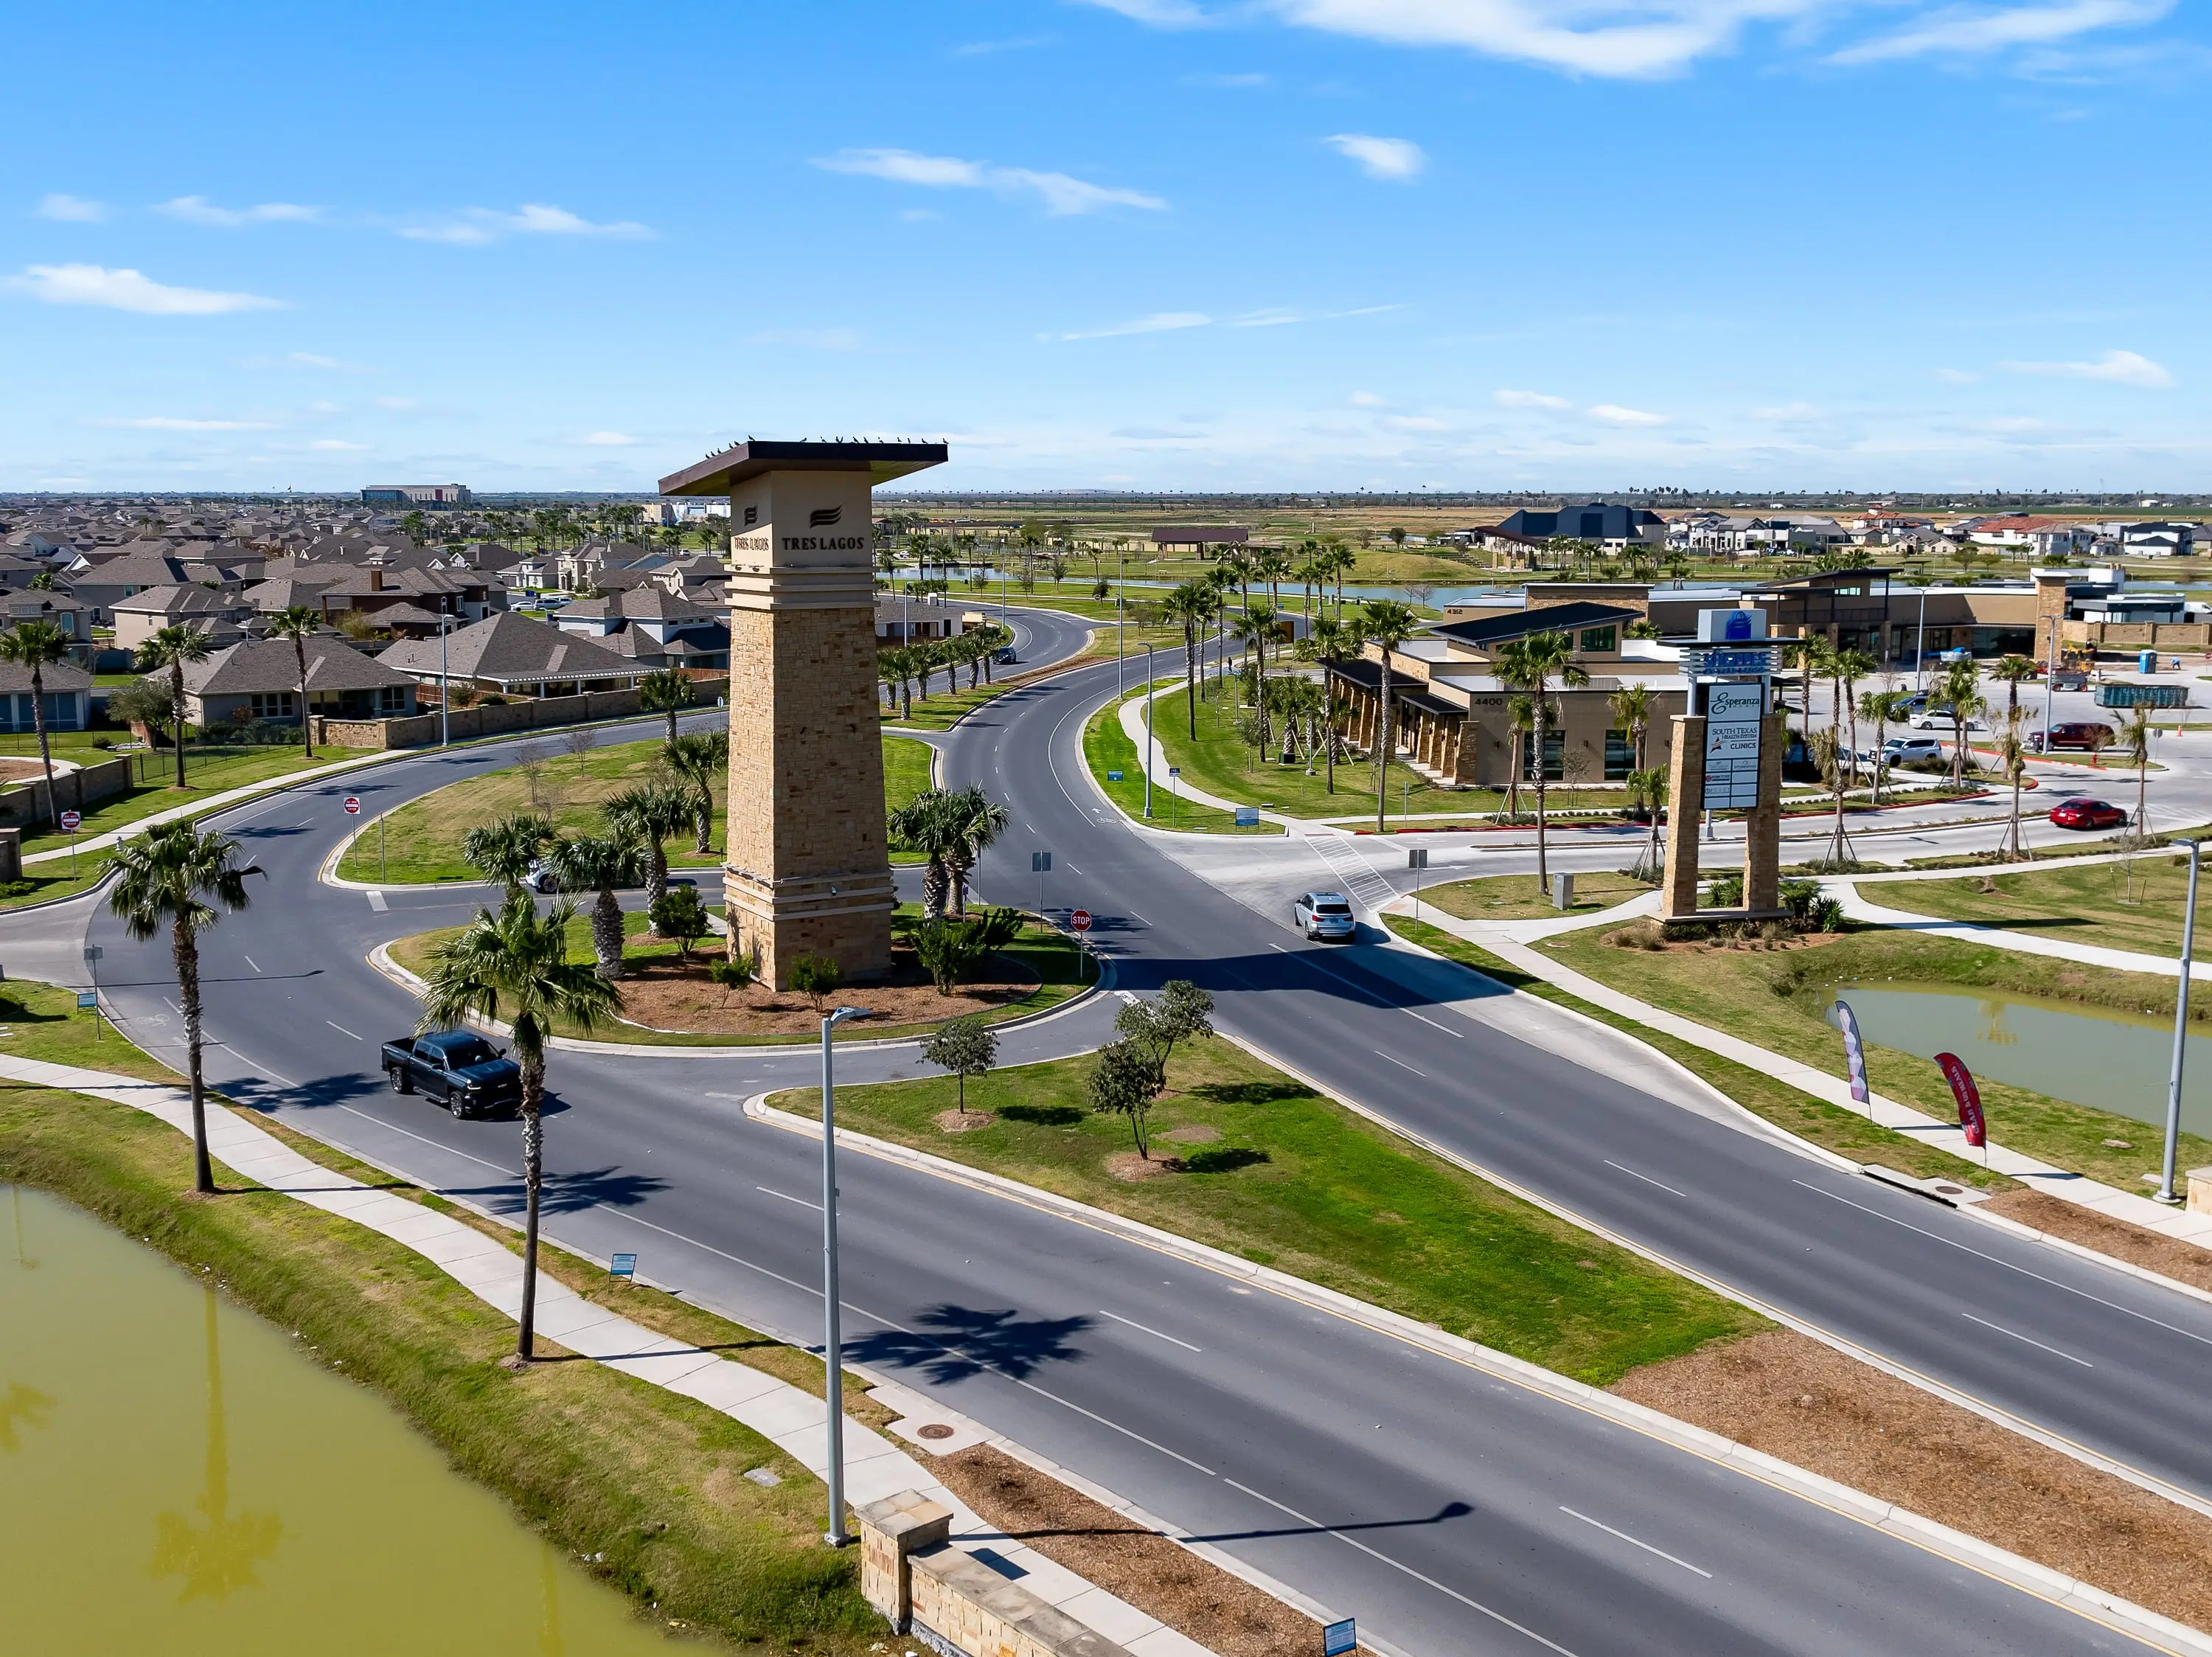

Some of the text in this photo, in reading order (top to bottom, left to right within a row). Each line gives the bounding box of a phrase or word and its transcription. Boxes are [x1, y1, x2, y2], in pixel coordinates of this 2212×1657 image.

[782, 537, 865, 550] TRES LAGOS
[1710, 692, 1760, 715] Esperanza
[1073, 916, 1090, 925] STOP
[1951, 1066, 1966, 1091] MEALS
